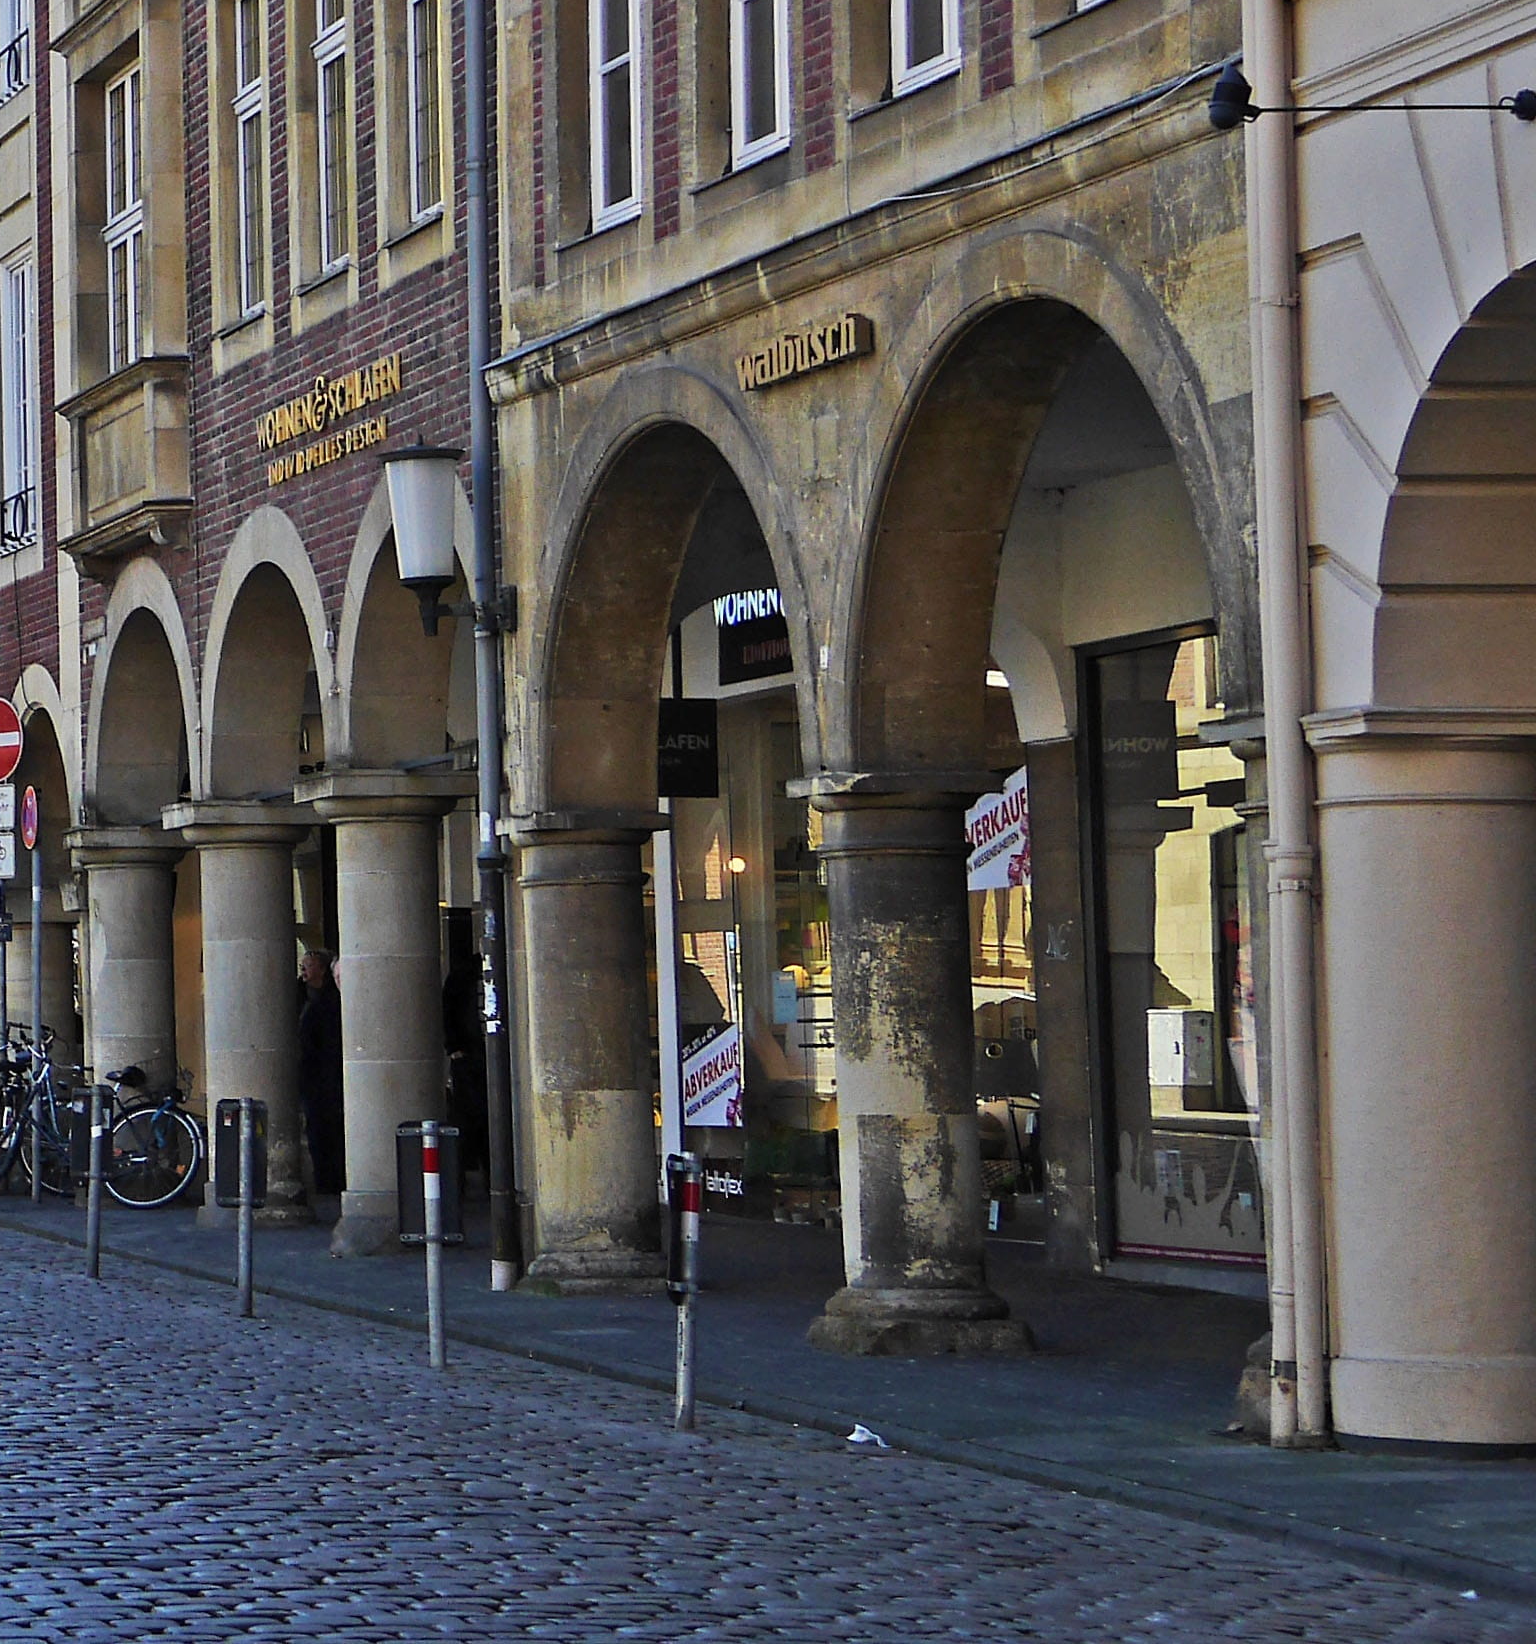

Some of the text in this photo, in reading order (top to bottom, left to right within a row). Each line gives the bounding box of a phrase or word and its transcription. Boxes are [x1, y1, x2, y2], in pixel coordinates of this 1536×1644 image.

[255, 392, 314, 452] WOHNEN
[328, 352, 402, 421] SCHLAFEN
[713, 587, 778, 627] WOHNEN
